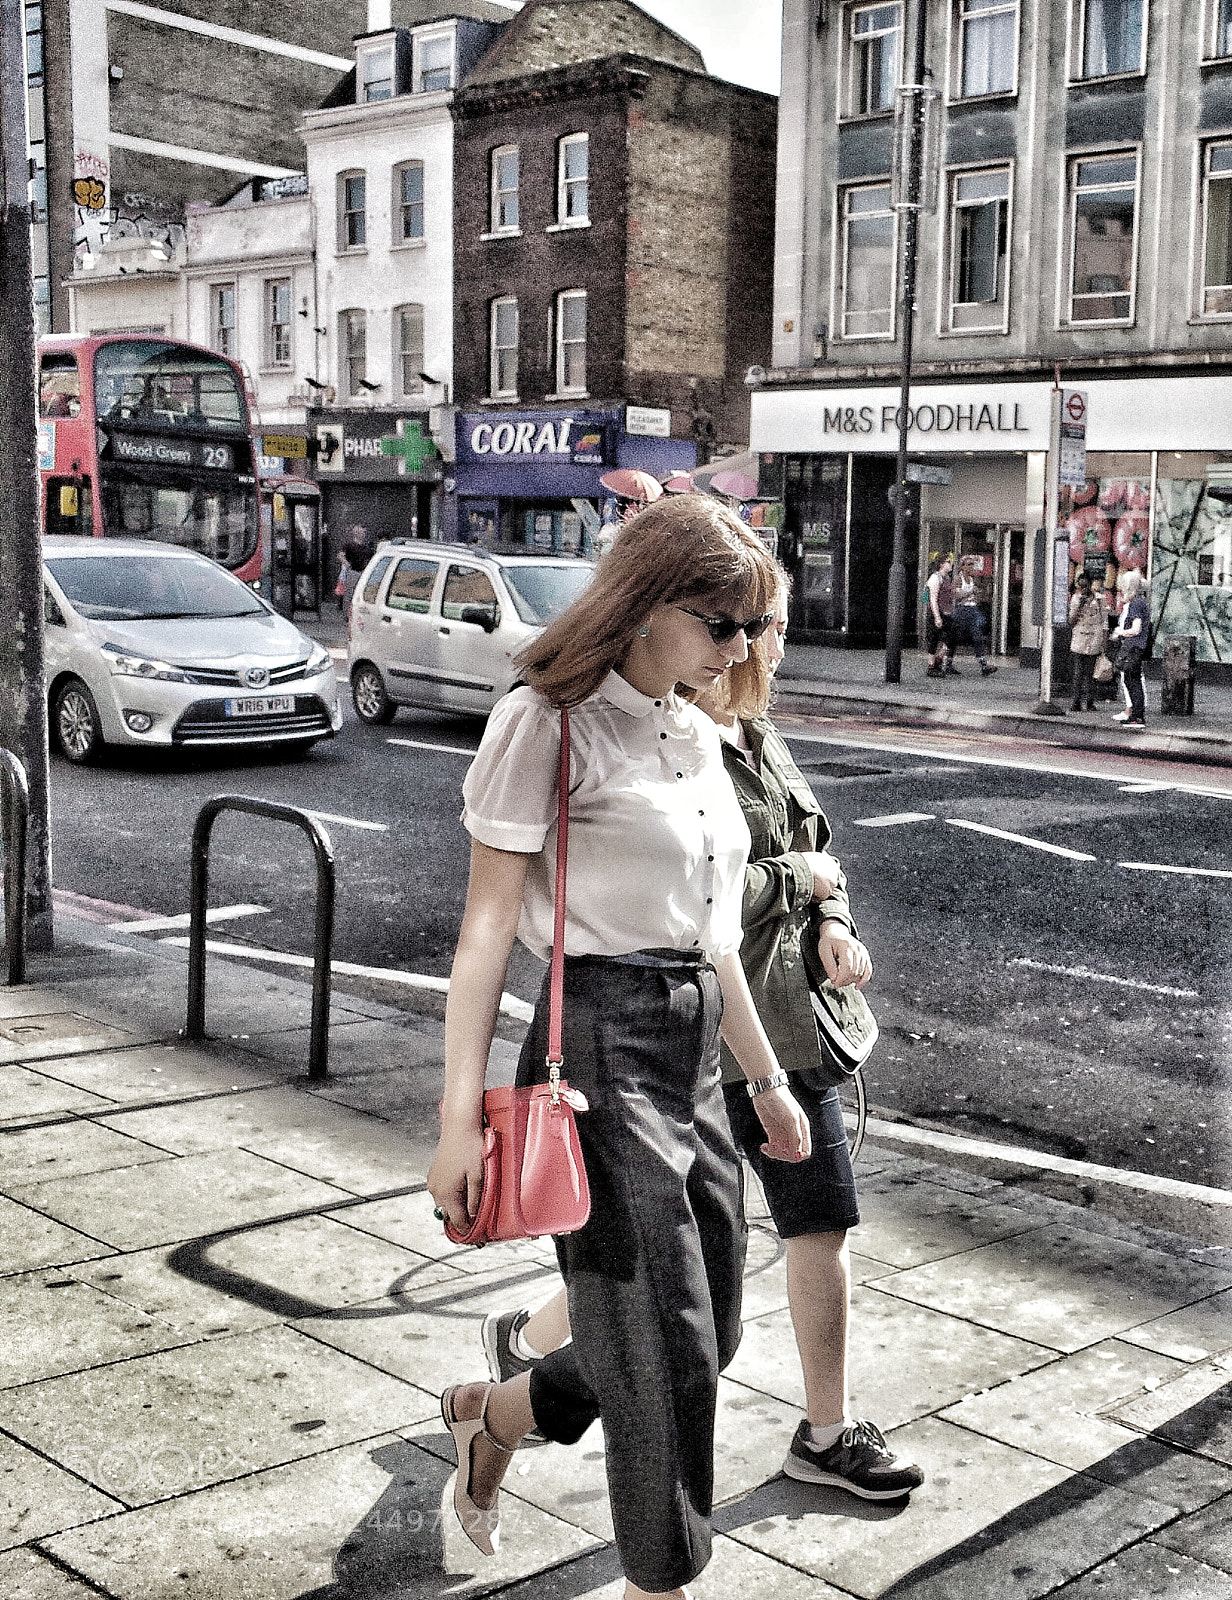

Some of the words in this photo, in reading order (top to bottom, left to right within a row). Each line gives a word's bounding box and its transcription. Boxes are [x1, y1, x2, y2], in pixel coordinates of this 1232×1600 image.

[823, 406, 872, 433] M&S
[881, 403, 1029, 432] FOODHALL
[470, 418, 573, 454] CORAL
[117, 440, 153, 457] Wood
[156, 445, 191, 461] Green
[202, 445, 229, 468] 29
